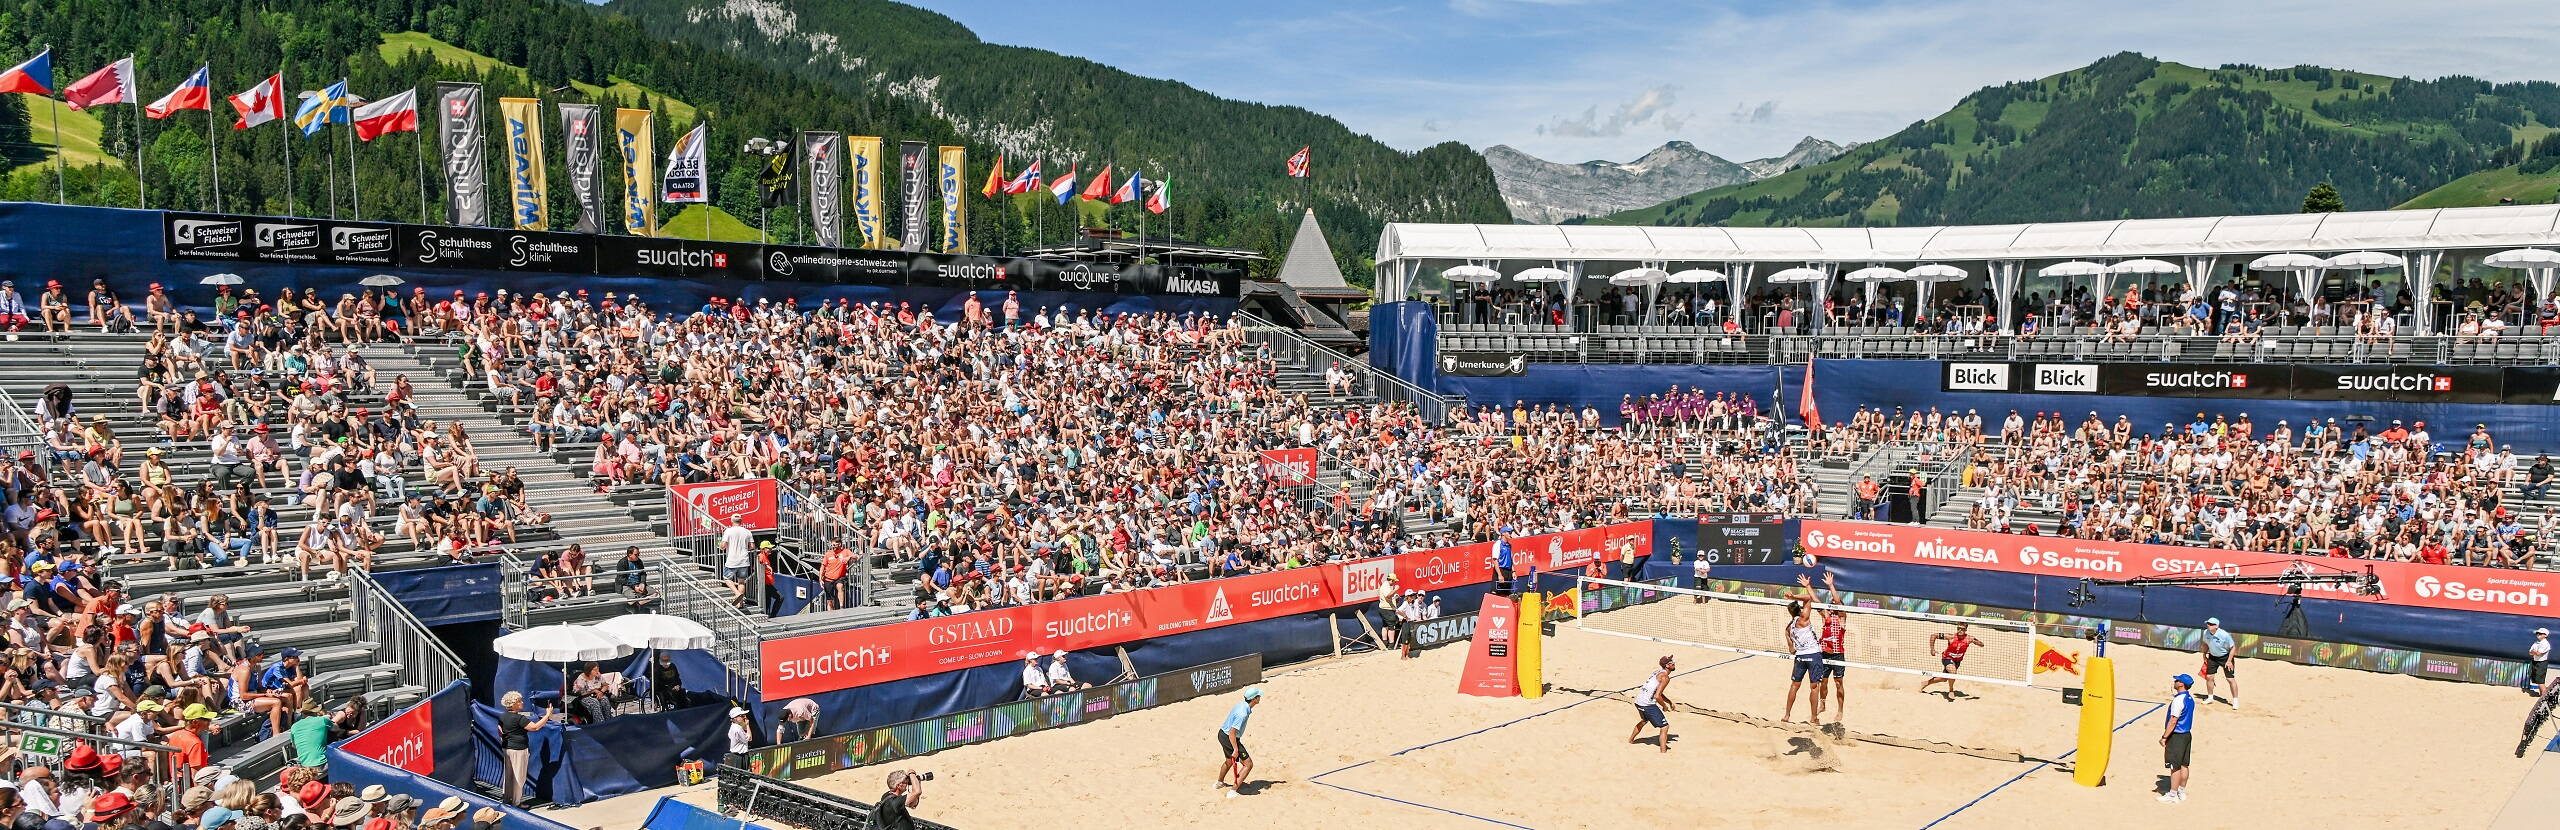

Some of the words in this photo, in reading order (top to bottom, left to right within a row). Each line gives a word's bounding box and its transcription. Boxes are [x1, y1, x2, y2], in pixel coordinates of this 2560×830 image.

[197, 227, 238, 236] Schweizer
[204, 234, 232, 244] Fleisch
[277, 230, 316, 240] Schweizer
[352, 233, 388, 243] Schweizer
[284, 238, 310, 247] Fleisch
[358, 240, 383, 250] Fleisch
[439, 238, 492, 250] schulthess
[530, 242, 578, 254] schulthess
[439, 248, 464, 260] klinik
[530, 252, 552, 263] klinik
[638, 249, 713, 268] swatch
[792, 255, 898, 268] onlinedrogerie-schweiz.ch
[938, 264, 994, 279] swatch
[1166, 272, 1220, 294] MIKASA
[1459, 360, 1505, 370] Urnerkurve
[1955, 370, 1997, 385] Blick
[2041, 370, 2085, 386] Blick
[2146, 371, 2228, 388] swatch
[2338, 374, 2432, 390] swatch
[712, 490, 756, 507] Schweizer
[720, 501, 749, 516] Fleisch
[1826, 534, 1896, 554] Senoh
[1914, 539, 1999, 564] MIKASA
[1708, 548, 1720, 563] 6
[1760, 548, 1772, 562] 7
[2042, 551, 2123, 572] Senoh
[2152, 557, 2240, 578] GSTAAD
[1348, 565, 1384, 595] Blick
[1251, 582, 1310, 607] swatch
[2444, 580, 2549, 607] Senoh
[1210, 596, 1229, 619] Sika
[1046, 609, 1118, 638] swatch
[1158, 622, 1180, 631] BUILDING
[1180, 619, 1198, 628] TRUST
[928, 617, 1013, 646] GSTAAD
[779, 646, 875, 681] swatch
